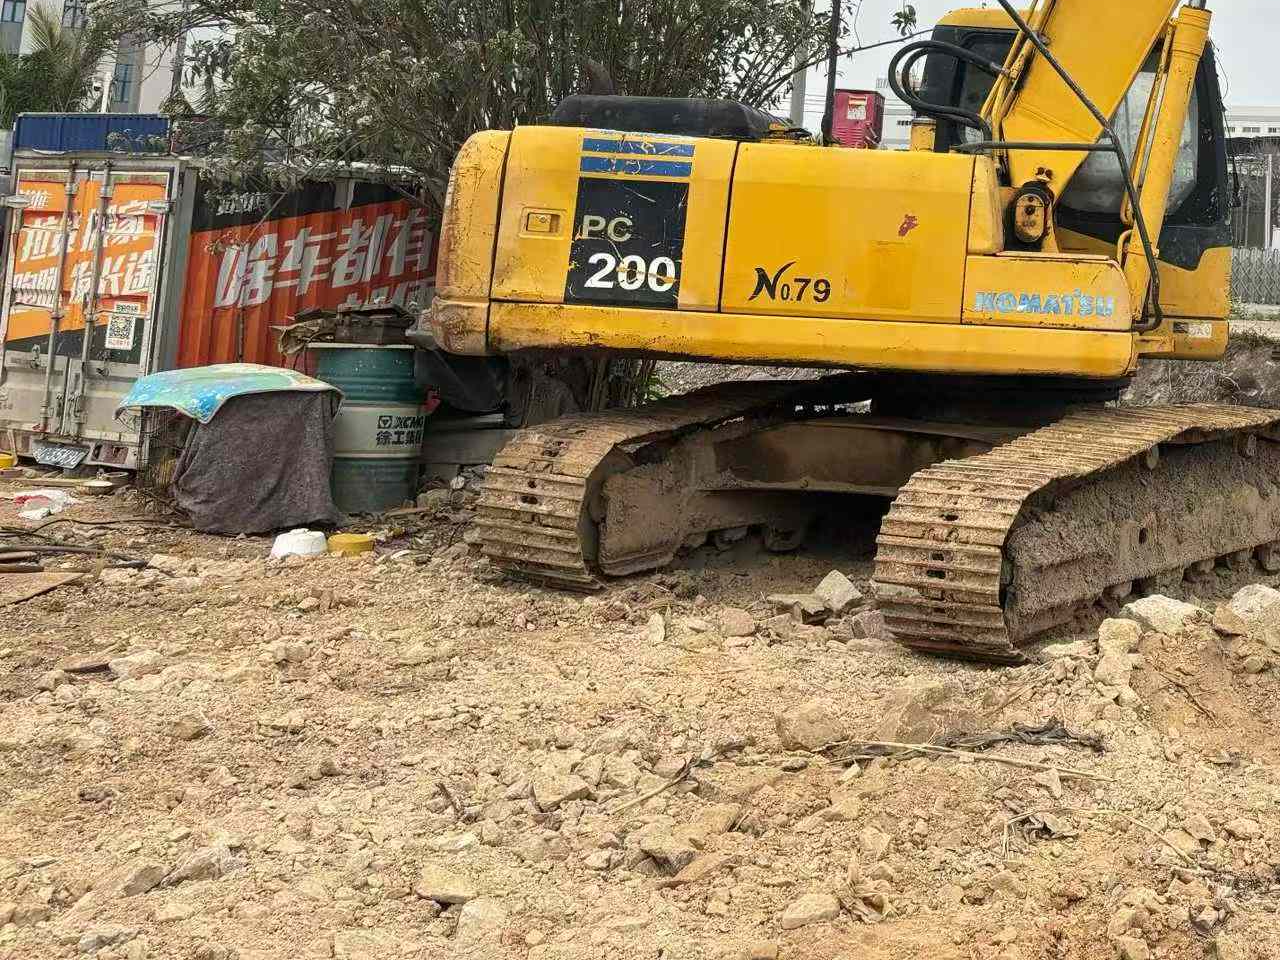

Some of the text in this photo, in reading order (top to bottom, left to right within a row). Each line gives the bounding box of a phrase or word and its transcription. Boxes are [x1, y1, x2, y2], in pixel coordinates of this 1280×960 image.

[582, 215, 633, 241] PC
[584, 253, 676, 292] 200
[975, 289, 1115, 317] KOMATSU
